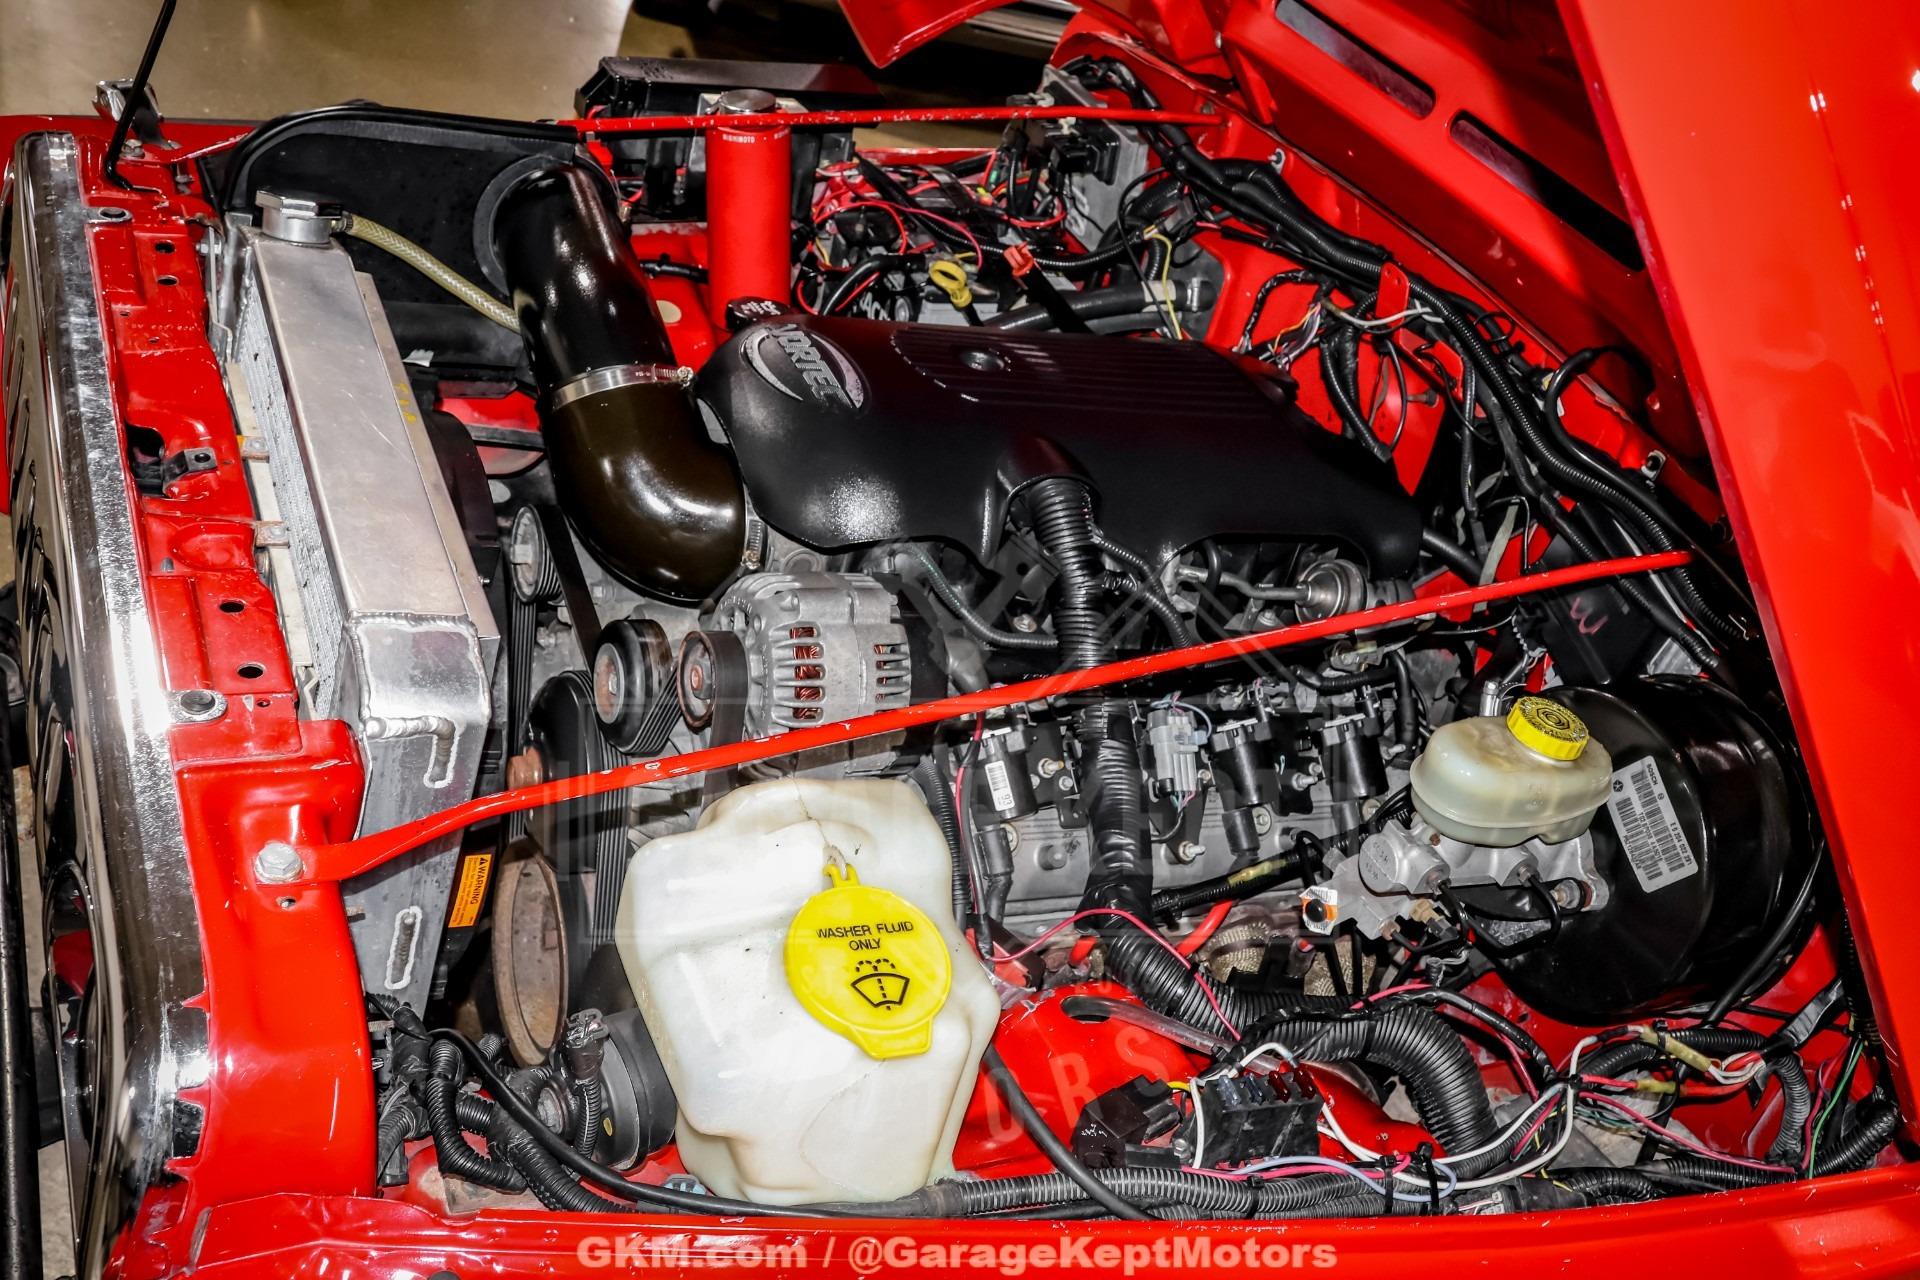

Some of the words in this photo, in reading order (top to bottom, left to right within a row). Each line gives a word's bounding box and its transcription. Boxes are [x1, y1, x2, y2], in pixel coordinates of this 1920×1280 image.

[1646, 763, 1659, 786] BOSCH
[470, 866, 486, 905] WARNING
[816, 924, 873, 939] WASHER
[877, 921, 914, 933] FLUID
[849, 938, 882, 951] ONLY
